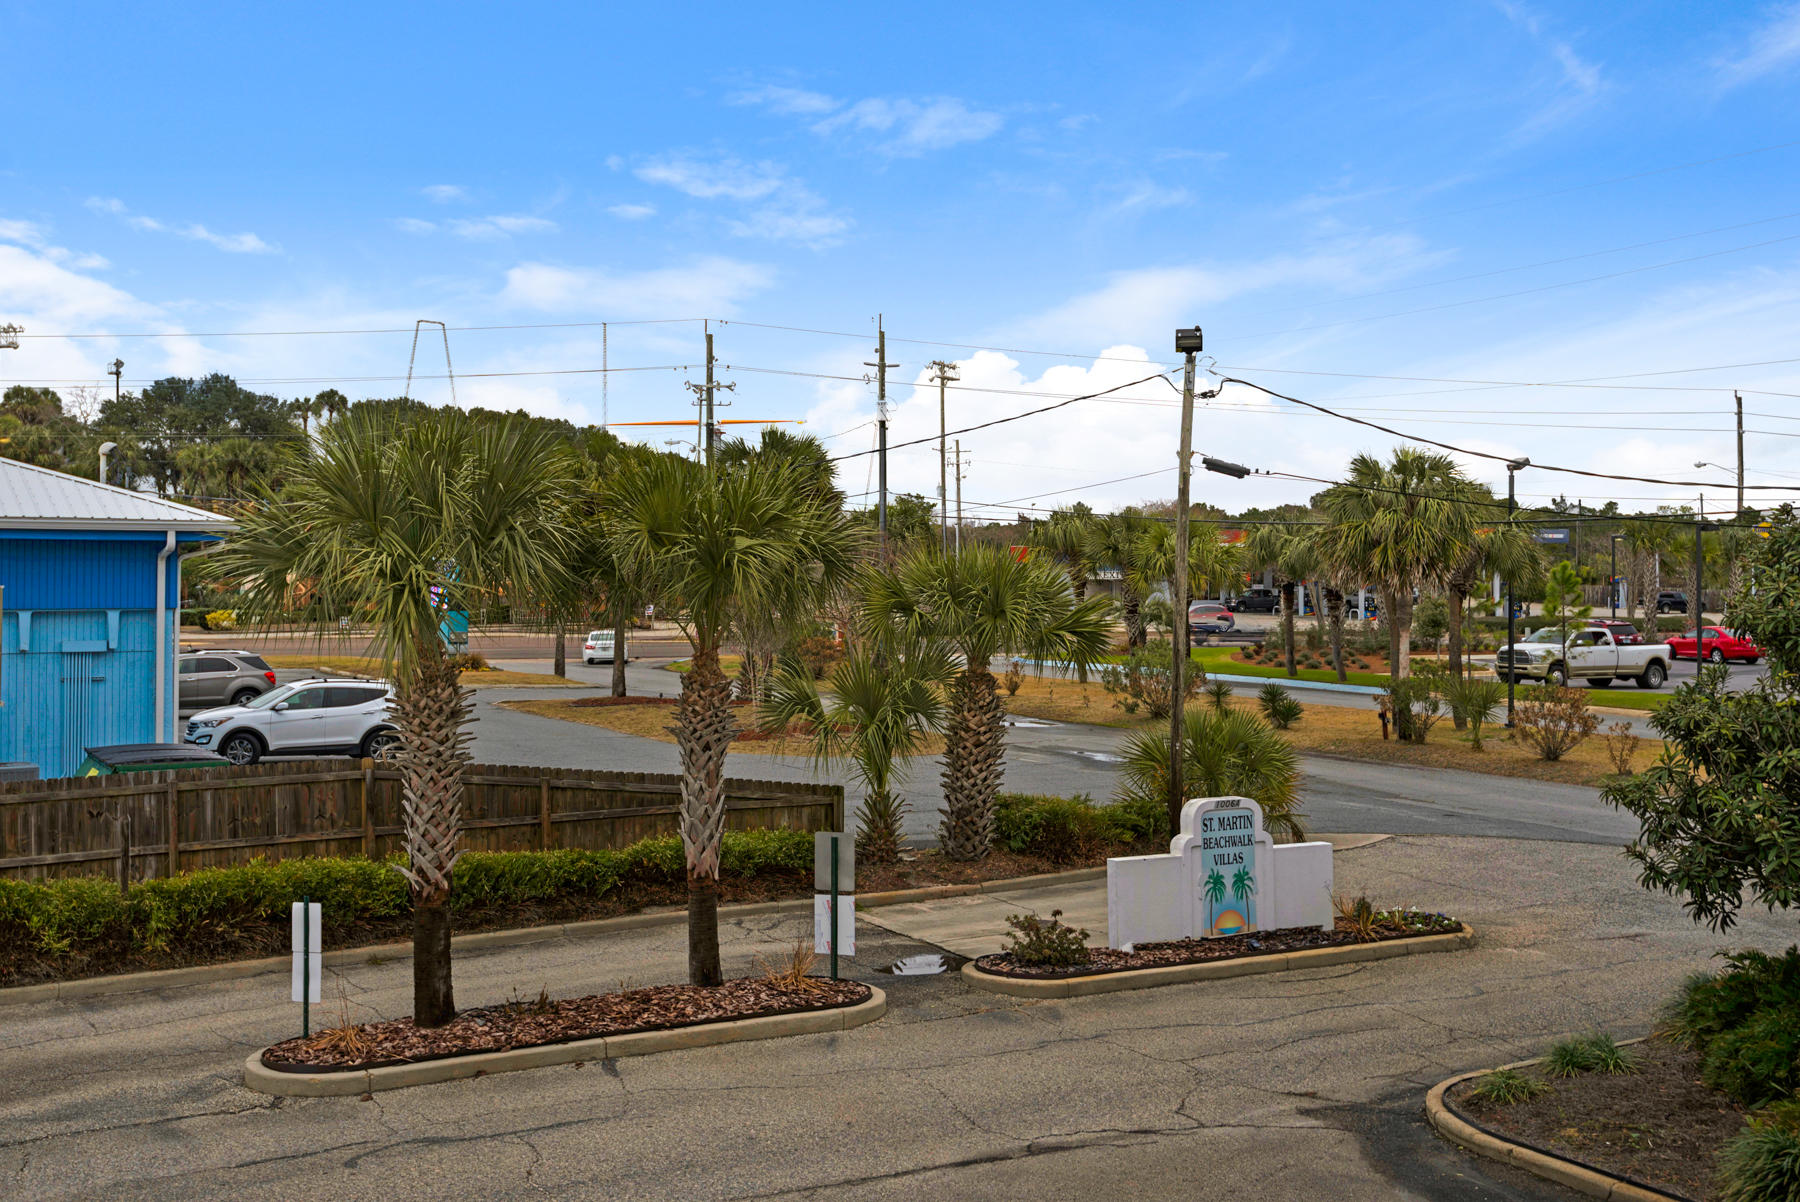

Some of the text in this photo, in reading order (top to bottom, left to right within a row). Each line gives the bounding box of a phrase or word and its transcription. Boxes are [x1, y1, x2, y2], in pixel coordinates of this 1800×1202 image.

[1202, 815, 1253, 833] ST. MARTIN
[1203, 834, 1254, 850] BEACHWALK
[1213, 852, 1244, 866] VILLAS
